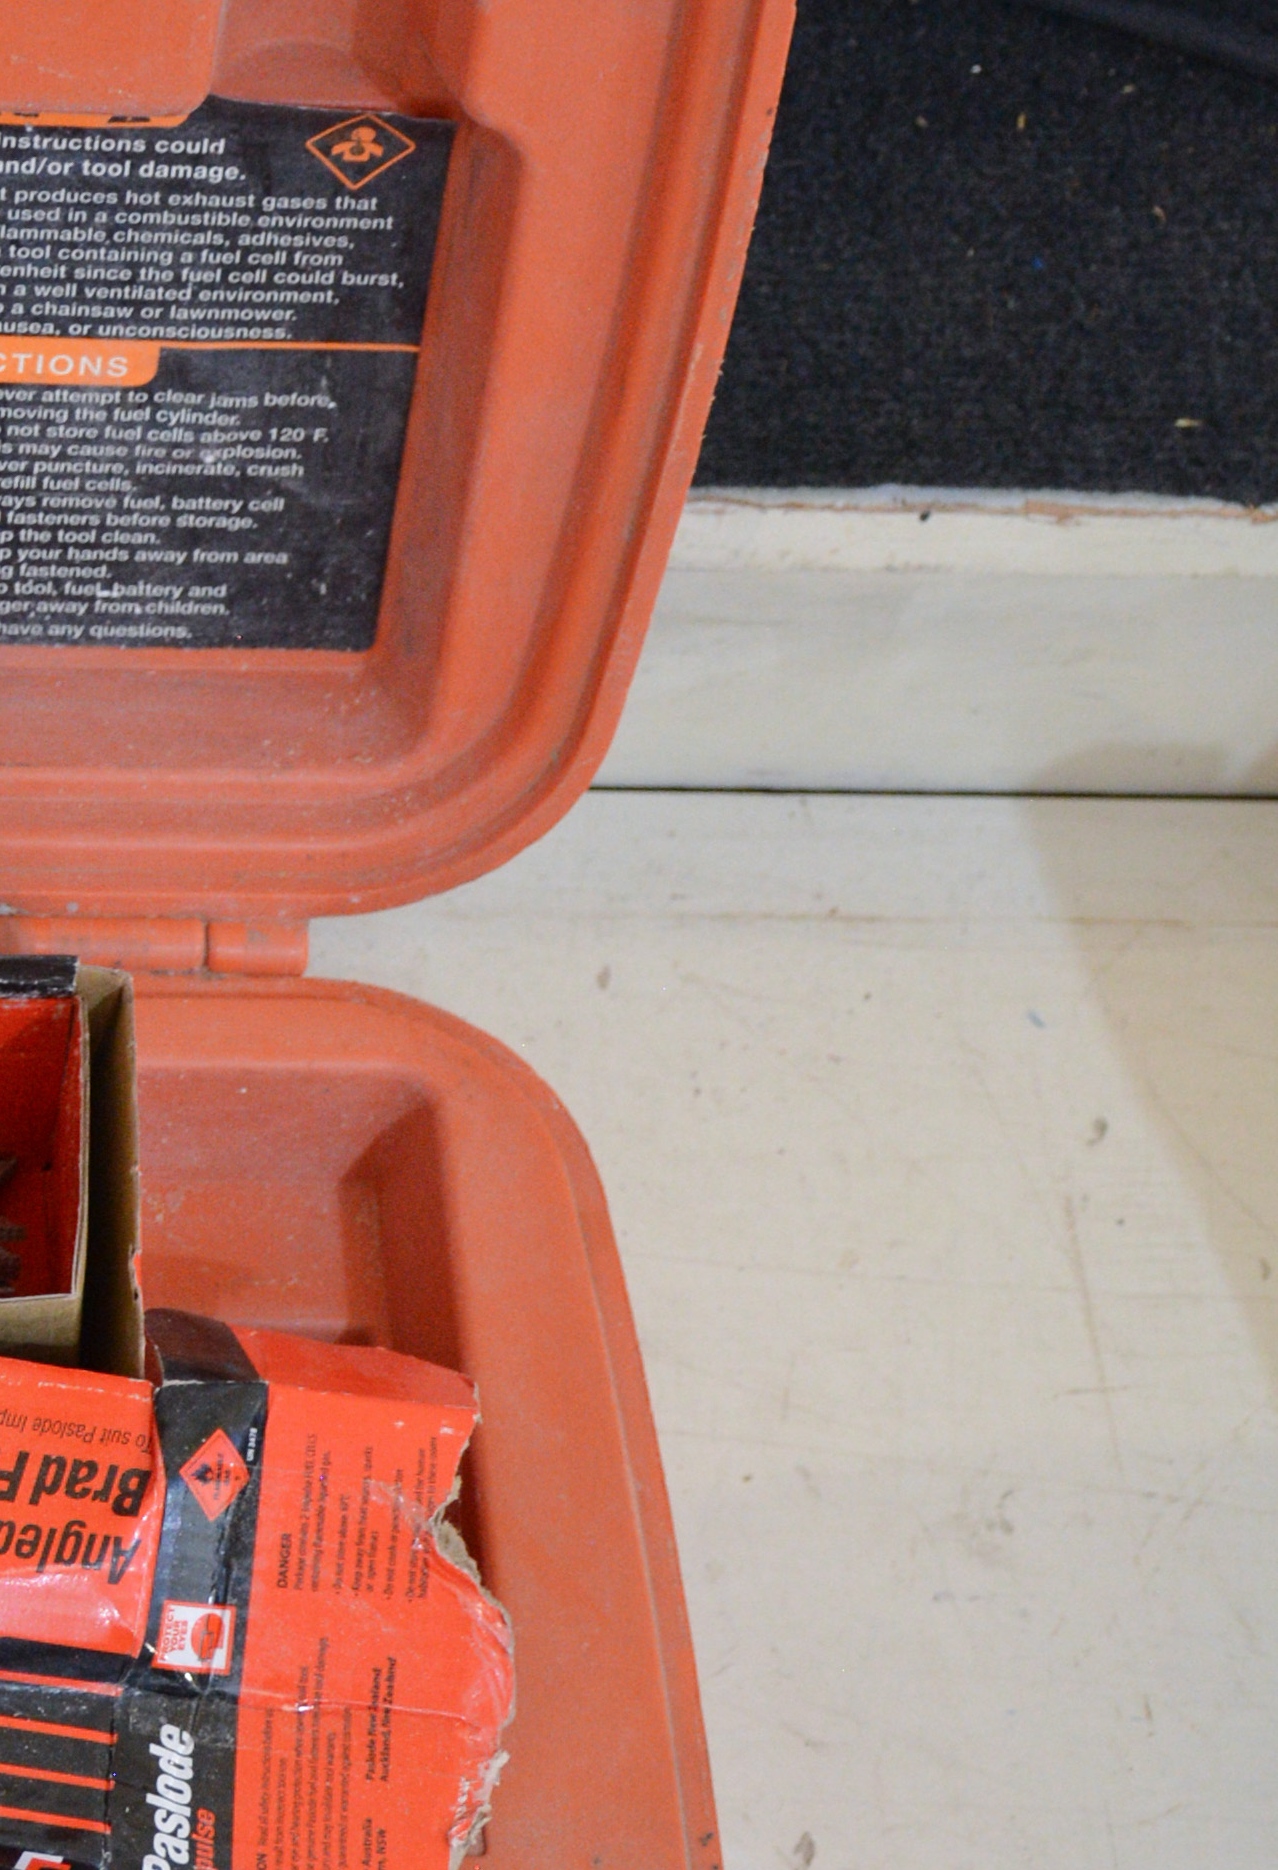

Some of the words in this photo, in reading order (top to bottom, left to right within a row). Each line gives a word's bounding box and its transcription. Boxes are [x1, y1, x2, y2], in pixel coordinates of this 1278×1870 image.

[155, 136, 225, 154] could
[82, 160, 130, 177] tool
[140, 162, 246, 184] damage.
[14, 188, 118, 208] produces
[126, 190, 161, 206] hot
[168, 192, 255, 208] exhaust
[262, 195, 327, 211] gases
[335, 195, 377, 211] that
[19, 528, 51, 543] the
[57, 528, 96, 543] tool
[105, 529, 161, 544] clean.
[33, 1415, 94, 1442] Paslode
[97, 1426, 131, 1447] suit
[30, 1455, 152, 1517] Brad
[277, 1533, 291, 1588] DANGER
[177, 1620, 189, 1650] EYES
[361, 1818, 373, 1866] Australia
